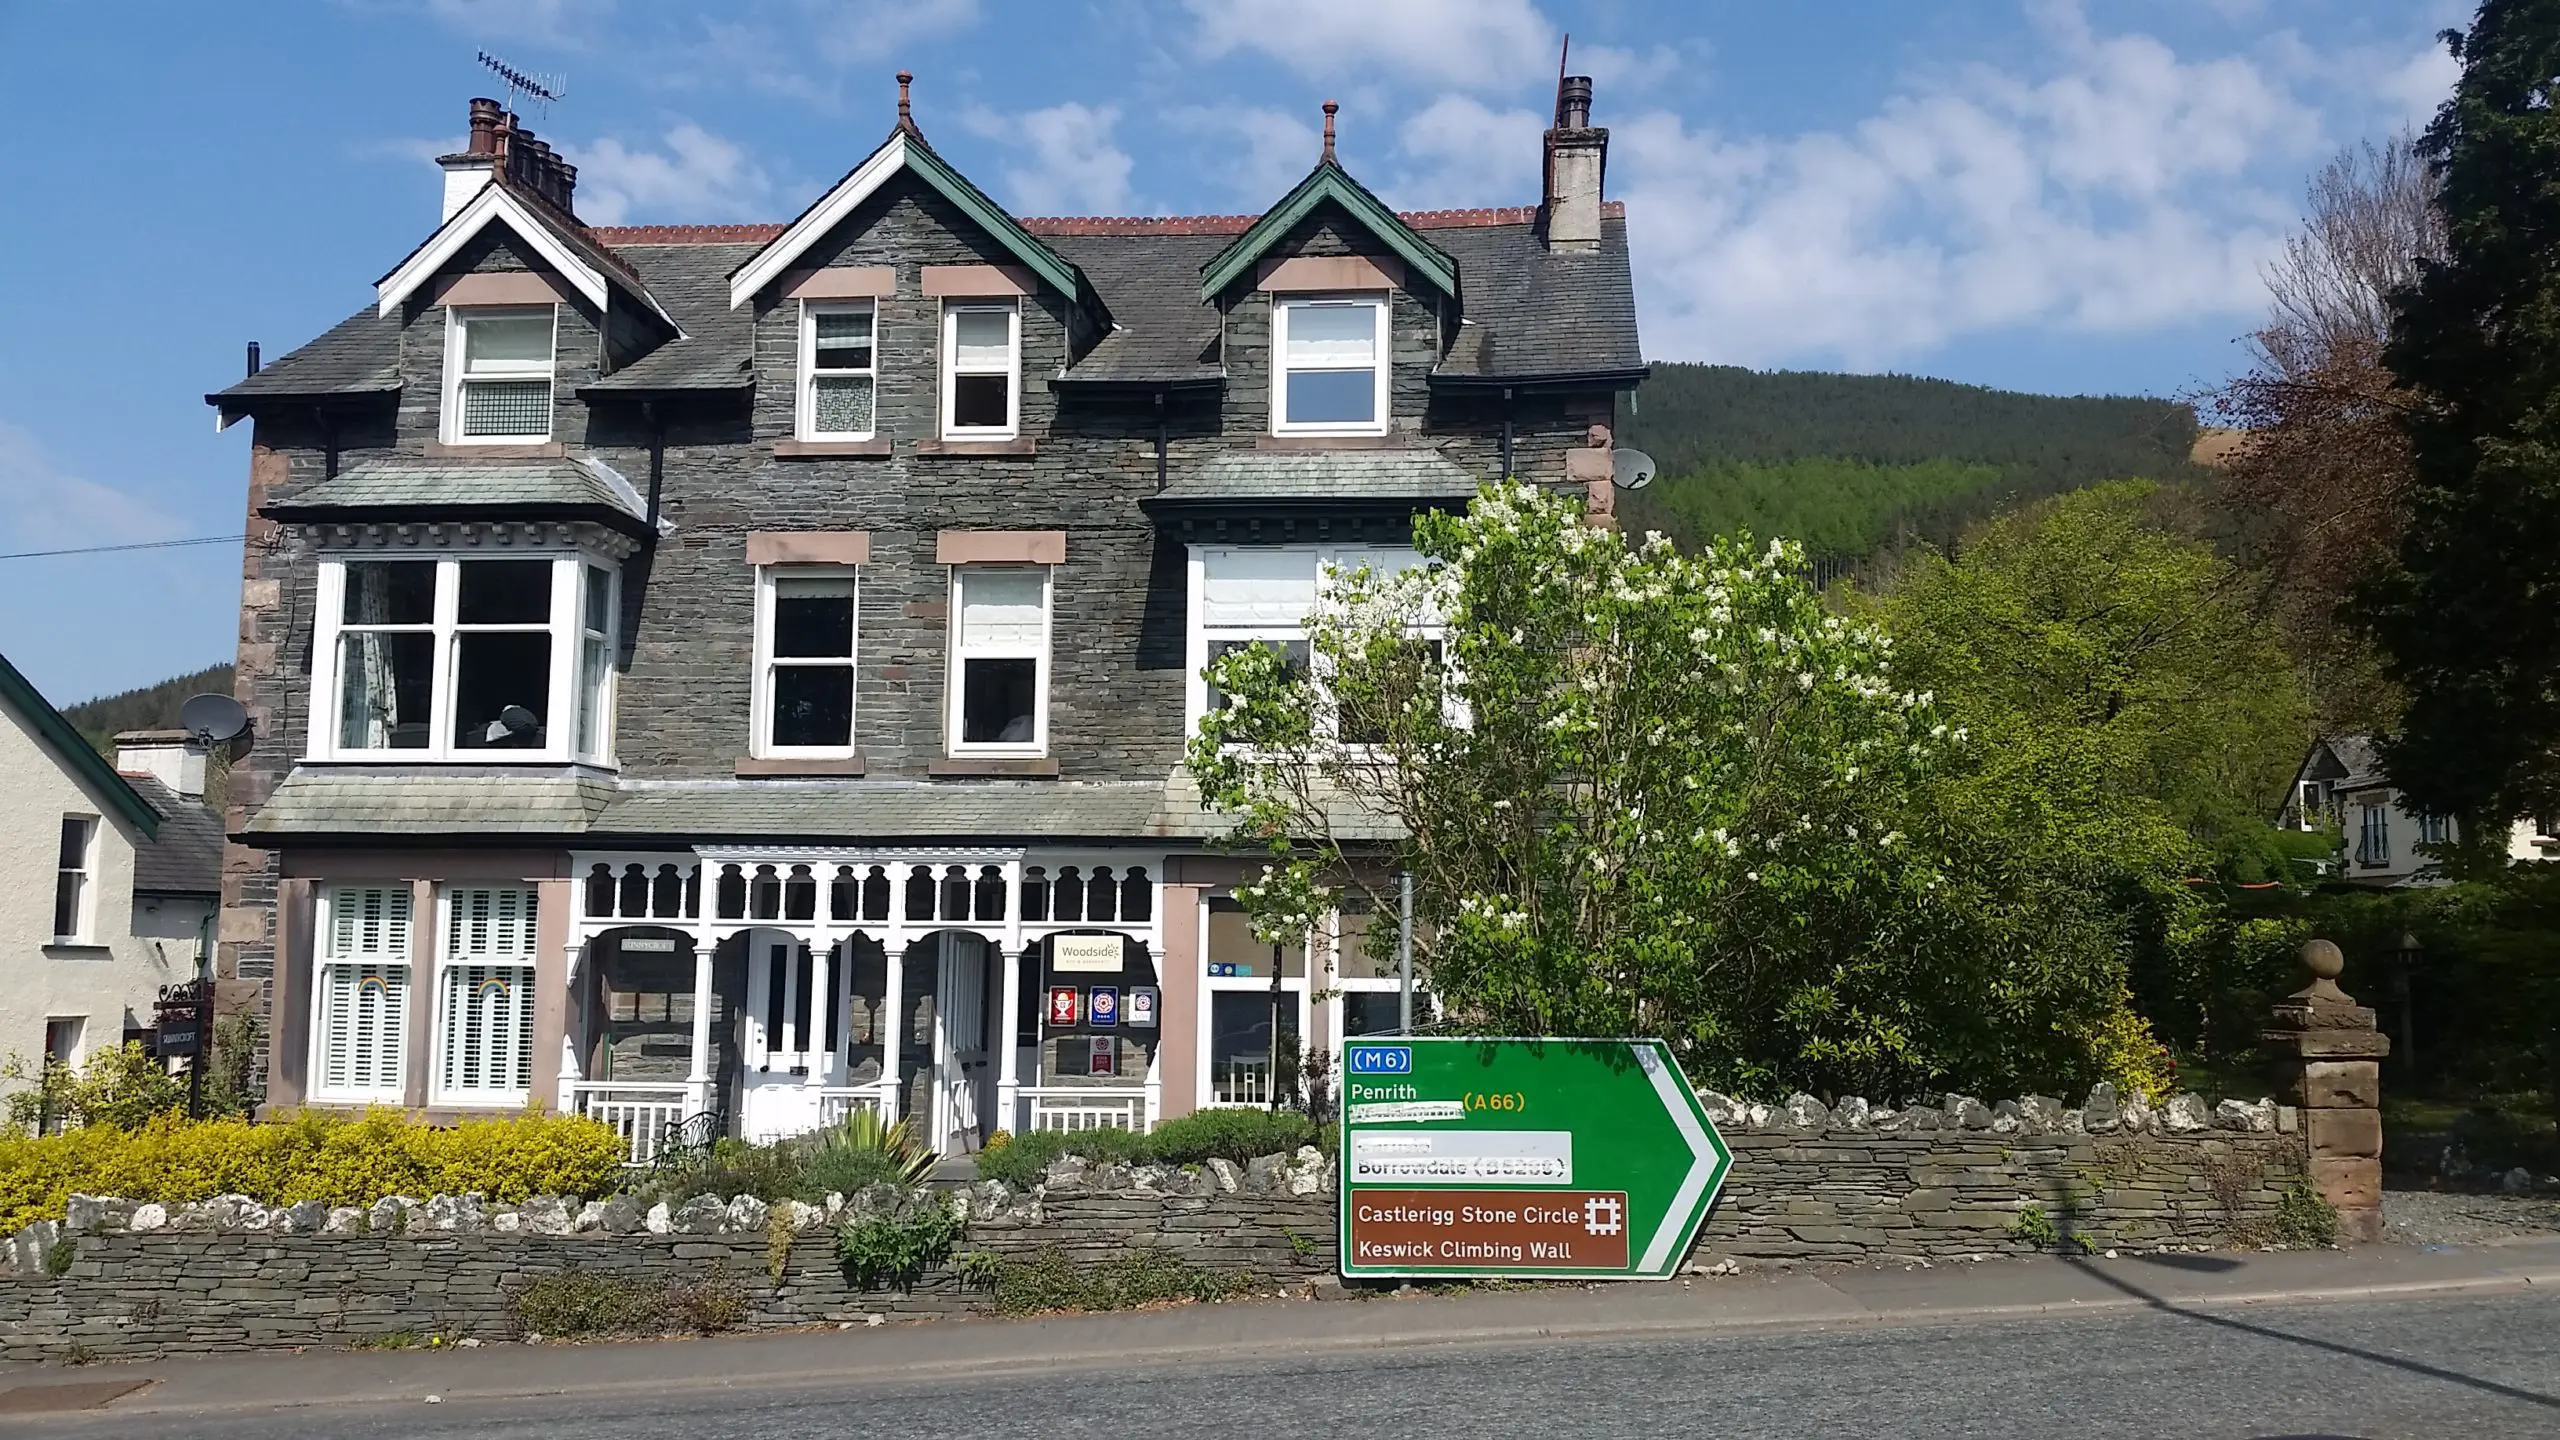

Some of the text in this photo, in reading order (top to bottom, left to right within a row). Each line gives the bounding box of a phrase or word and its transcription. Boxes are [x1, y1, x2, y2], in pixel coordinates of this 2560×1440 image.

[1062, 946, 1114, 957] Woodside
[1355, 1050, 1407, 1070] (M6)
[1351, 1084, 1417, 1099] Penrith
[1464, 1092, 1525, 1112] (A66)
[1358, 1205, 1579, 1226] Castlerigg Stone Circle
[1360, 1240, 1571, 1261] Keswick Climbing Wall
